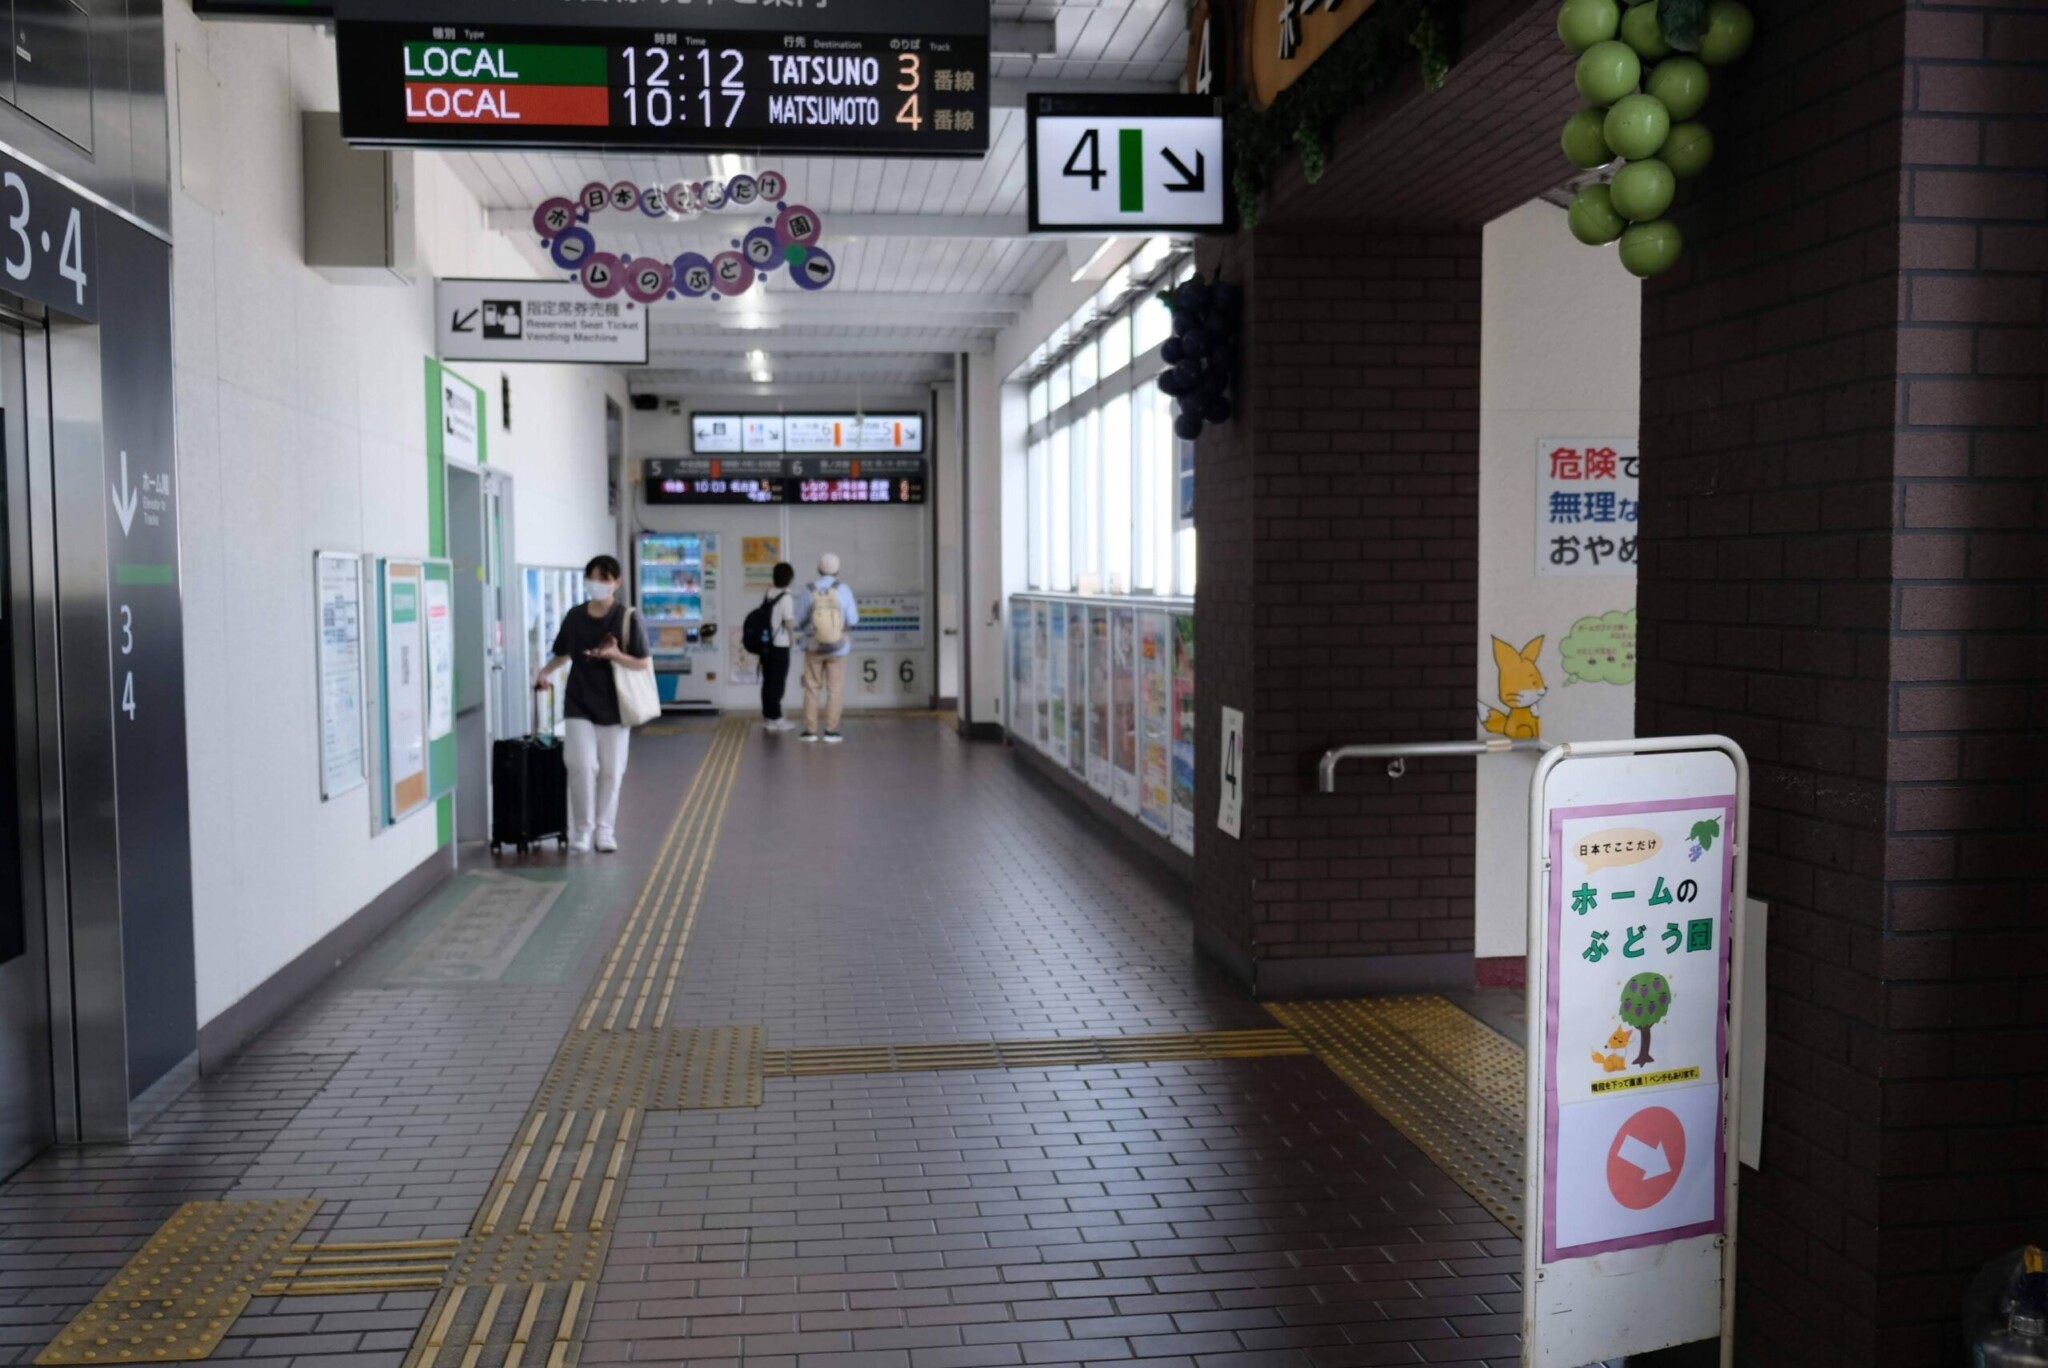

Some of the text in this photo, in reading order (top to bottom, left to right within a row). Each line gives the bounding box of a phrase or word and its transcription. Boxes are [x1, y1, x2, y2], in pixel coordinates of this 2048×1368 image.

[464, 29, 485, 41] Type
[654, 32, 677, 46] 時刻
[685, 36, 706, 46] Time
[784, 36, 806, 48] 行先
[814, 39, 862, 50] Destination
[890, 39, 921, 50] のりば
[930, 43, 951, 51] Track
[404, 46, 975, 92] LOCAL 12:12 TATSUNO 3 番線
[406, 86, 975, 131] LOCAL 10:17 MATSUMOTO 4 番線
[1062, 129, 1107, 191] 4
[526, 319, 639, 331] Reserved Seat Ticket
[526, 333, 618, 344] Vending Machine
[1549, 447, 1639, 480] 危険で
[1549, 490, 1638, 524] 無理な
[1550, 535, 1638, 566] おやめ
[121, 605, 133, 654] 3
[863, 659, 877, 684] 5
[900, 659, 914, 684] 6
[122, 671, 136, 721] 4
[1225, 730, 1237, 800] 4
[1579, 839, 1657, 857] 日本でここだけ
[1571, 876, 1698, 916] ホームの
[1582, 917, 1713, 963] ぶどう園
